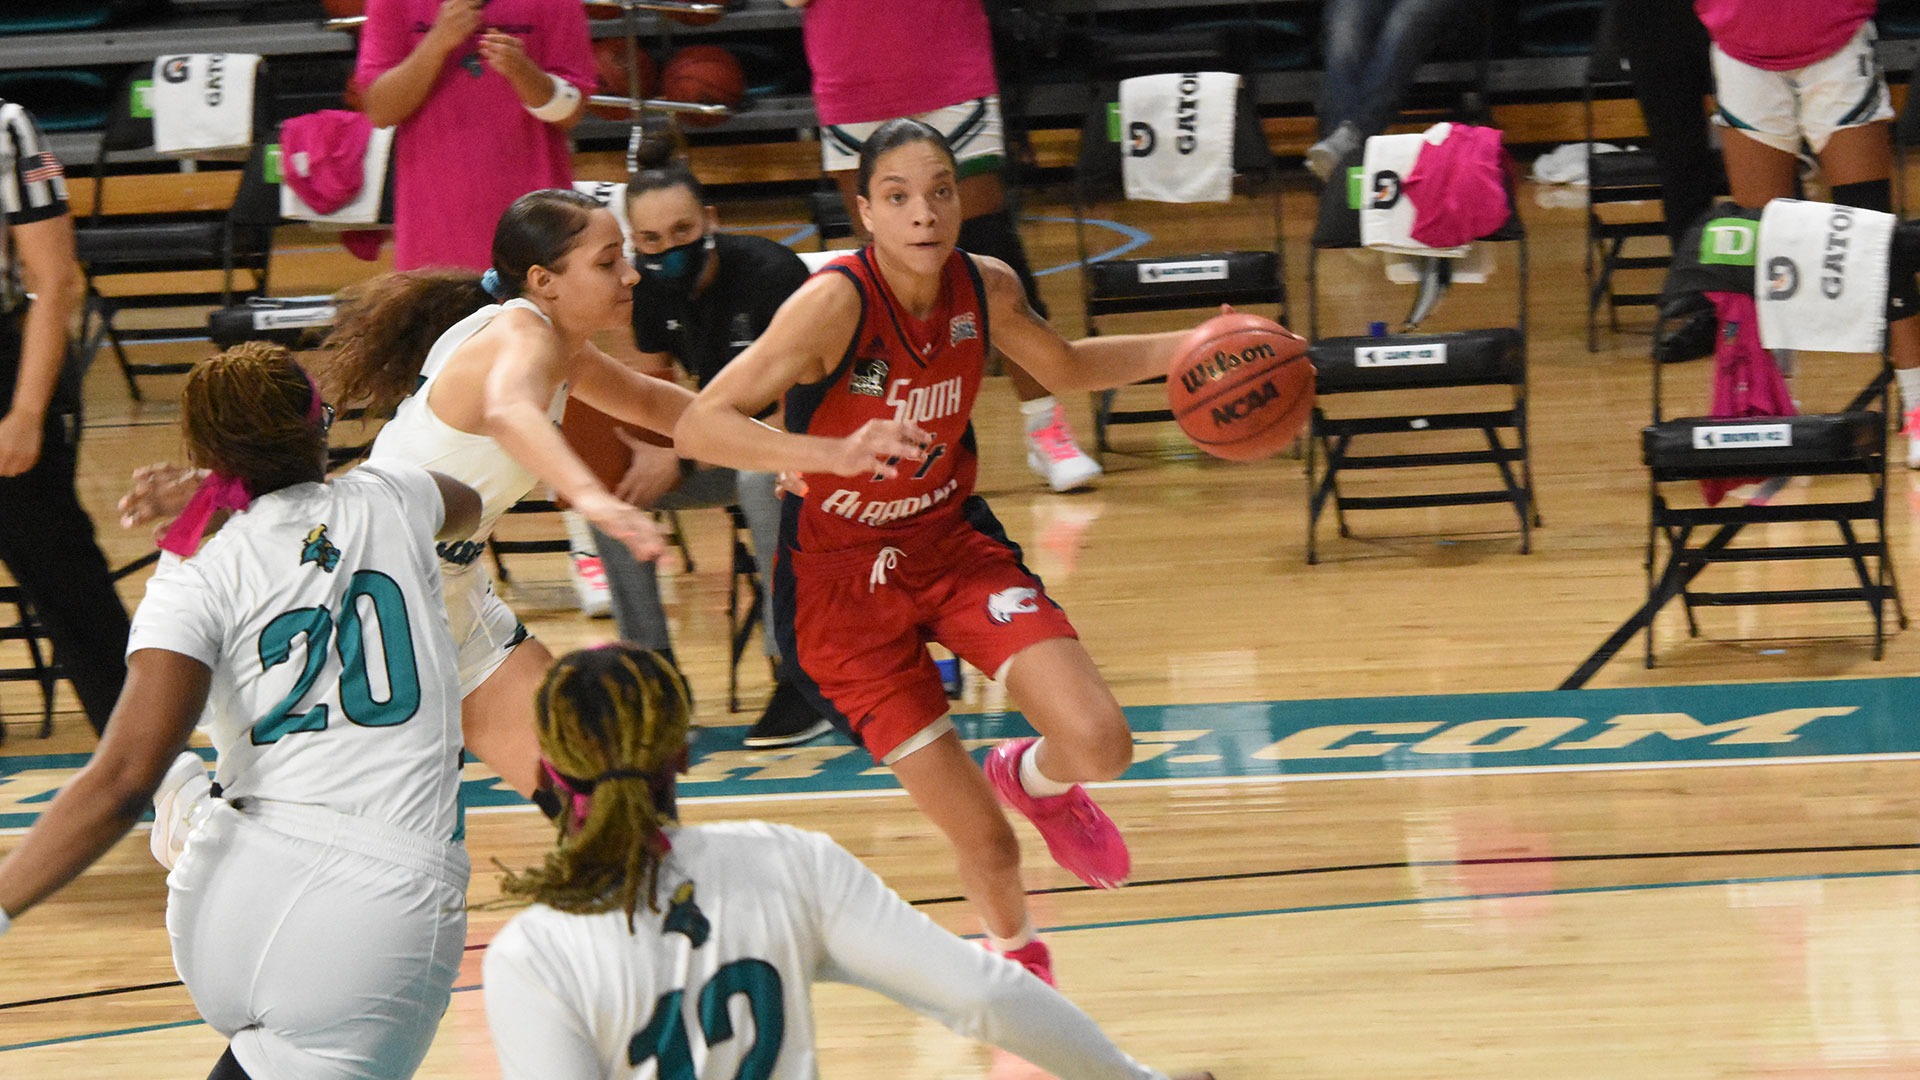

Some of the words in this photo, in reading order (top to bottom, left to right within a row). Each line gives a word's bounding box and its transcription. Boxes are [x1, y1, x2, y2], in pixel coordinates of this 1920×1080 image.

[1181, 343, 1276, 393] Wilson
[1211, 381, 1279, 425] NCAA
[250, 569, 421, 746] 20
[627, 957, 786, 1080] 12
